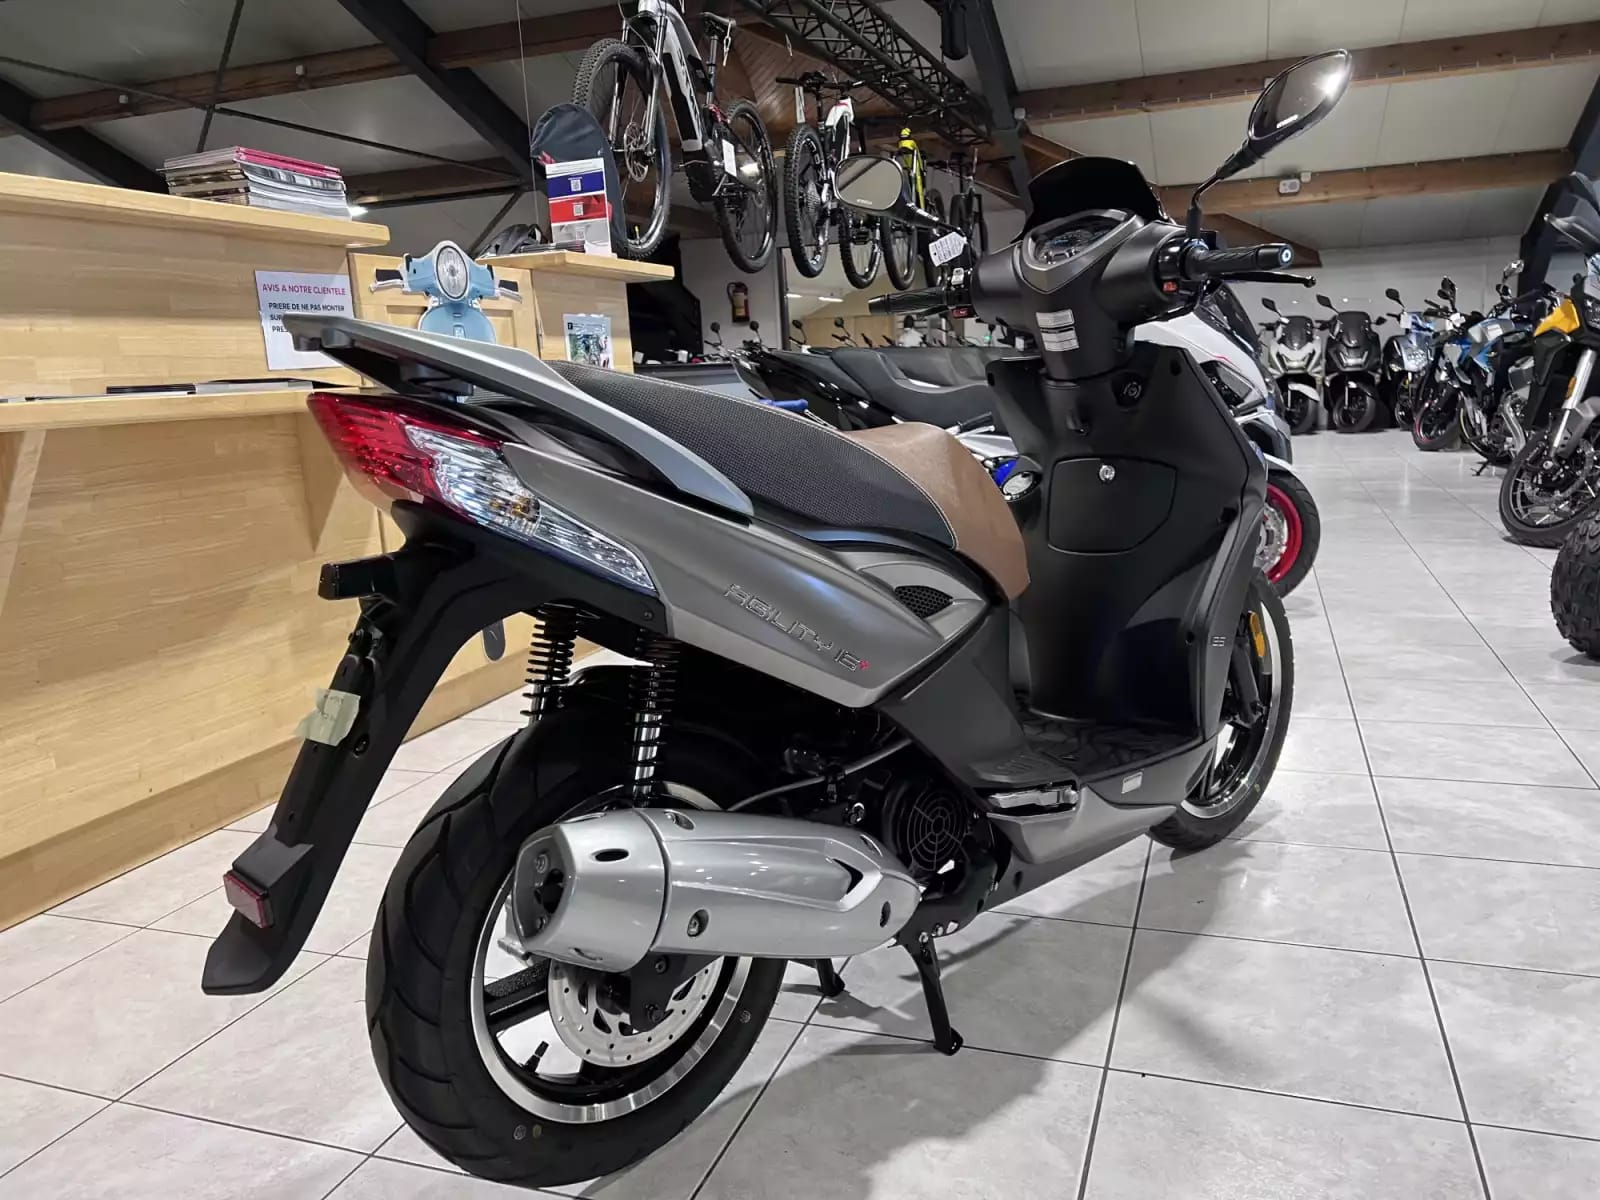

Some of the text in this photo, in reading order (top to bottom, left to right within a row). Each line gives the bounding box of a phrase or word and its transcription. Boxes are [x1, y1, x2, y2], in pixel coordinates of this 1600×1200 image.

[262, 284, 346, 296] AVIS A NOTRE CLIENTELE
[268, 302, 290, 310] PRIERE
[291, 303, 300, 311] DE
[272, 325, 288, 333] PRE
[724, 583, 834, 651] AGILITY
